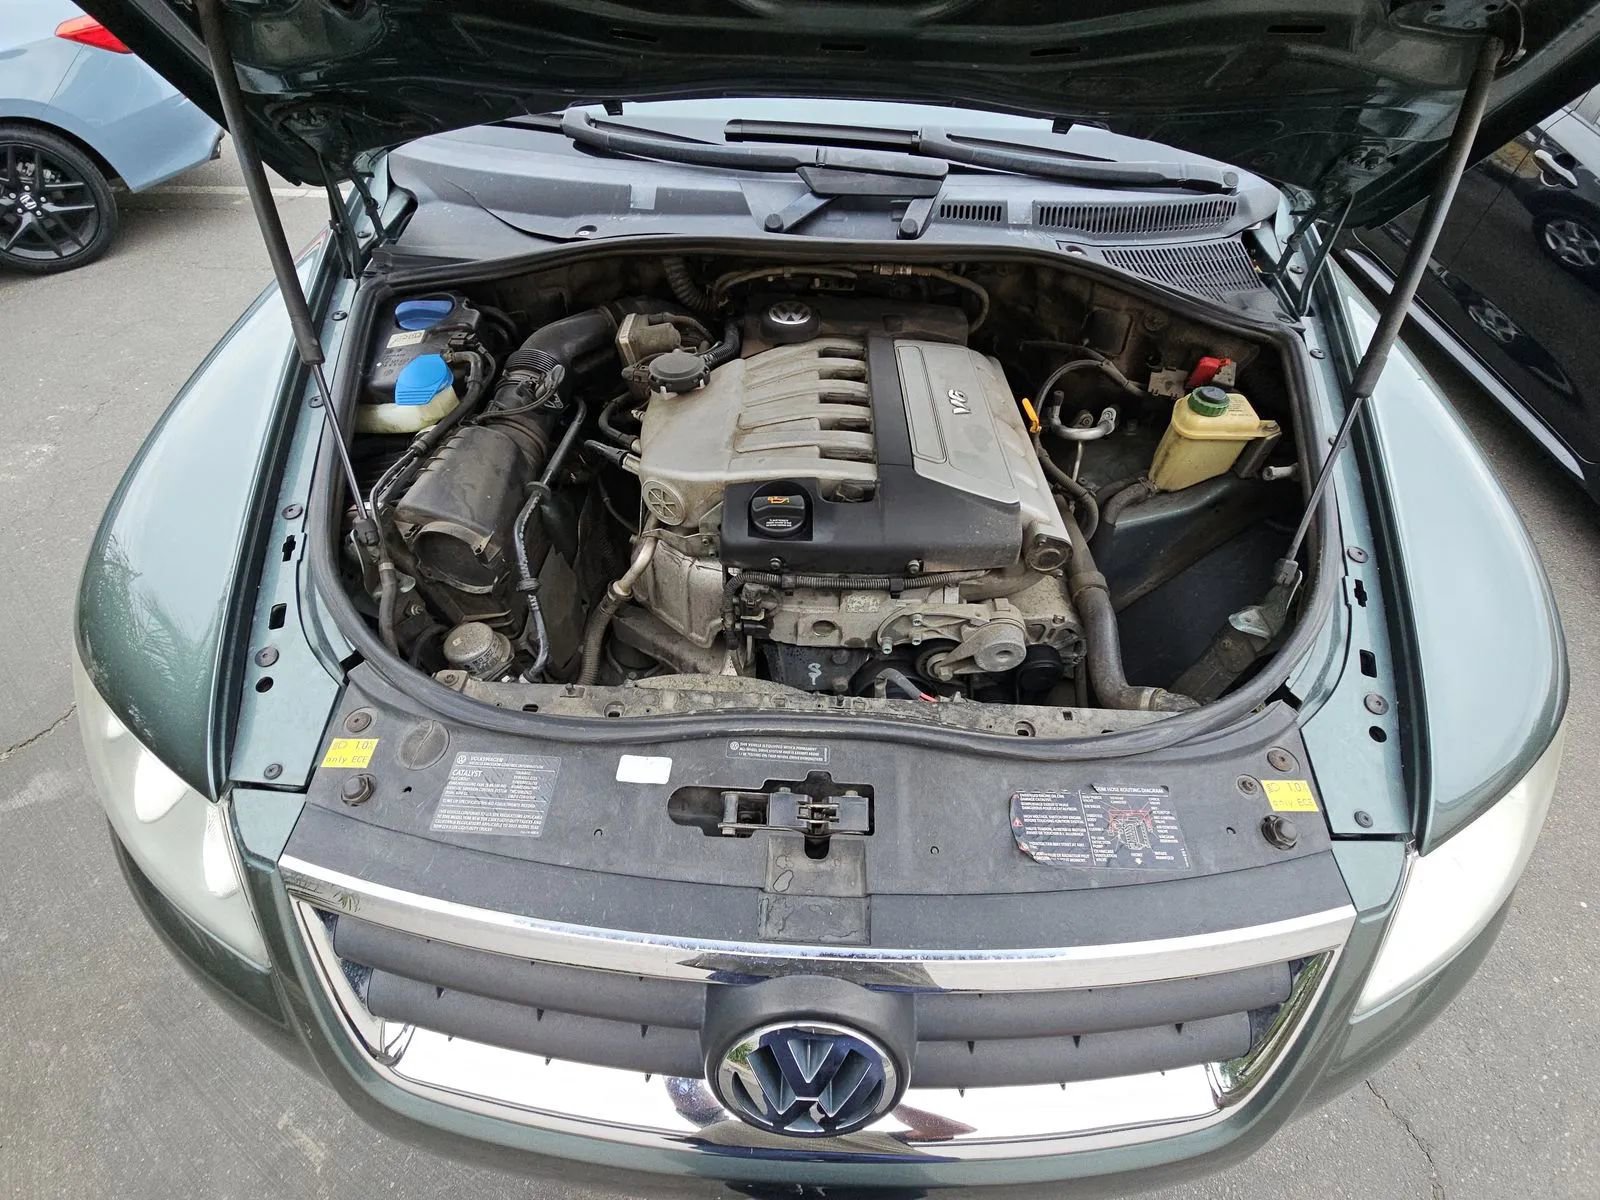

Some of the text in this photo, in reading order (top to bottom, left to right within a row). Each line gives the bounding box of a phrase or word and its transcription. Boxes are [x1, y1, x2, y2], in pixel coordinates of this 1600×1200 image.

[947, 388, 971, 415] V6
[452, 769, 483, 777] CATALYST
[716, 1020, 897, 1138] VW
